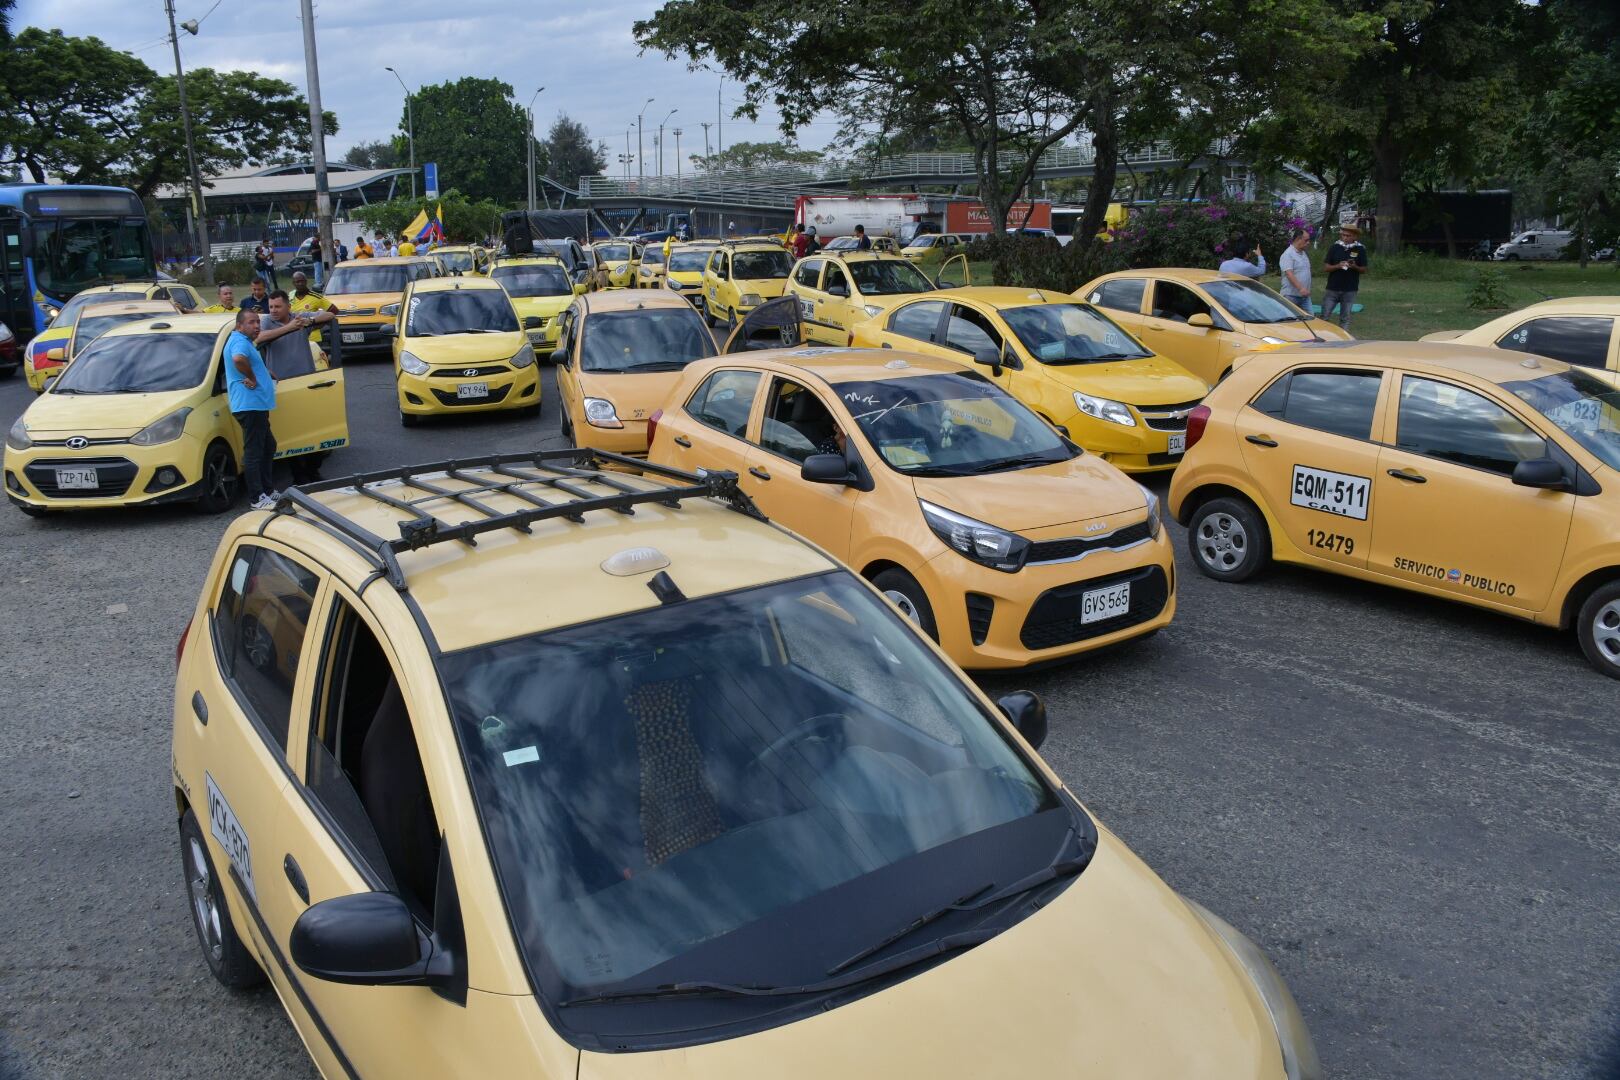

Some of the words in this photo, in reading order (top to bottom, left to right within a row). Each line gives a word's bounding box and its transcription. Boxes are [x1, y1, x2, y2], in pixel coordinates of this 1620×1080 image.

[1573, 401, 1598, 420] 823
[1294, 472, 1366, 508] EQM-511
[1308, 501, 1347, 515] CALI
[1307, 528, 1354, 555] 12479
[1393, 556, 1446, 580] SERVICIO
[1463, 573, 1516, 597] PUBLICO
[1084, 594, 1106, 615] GVS
[1108, 588, 1129, 609] 565
